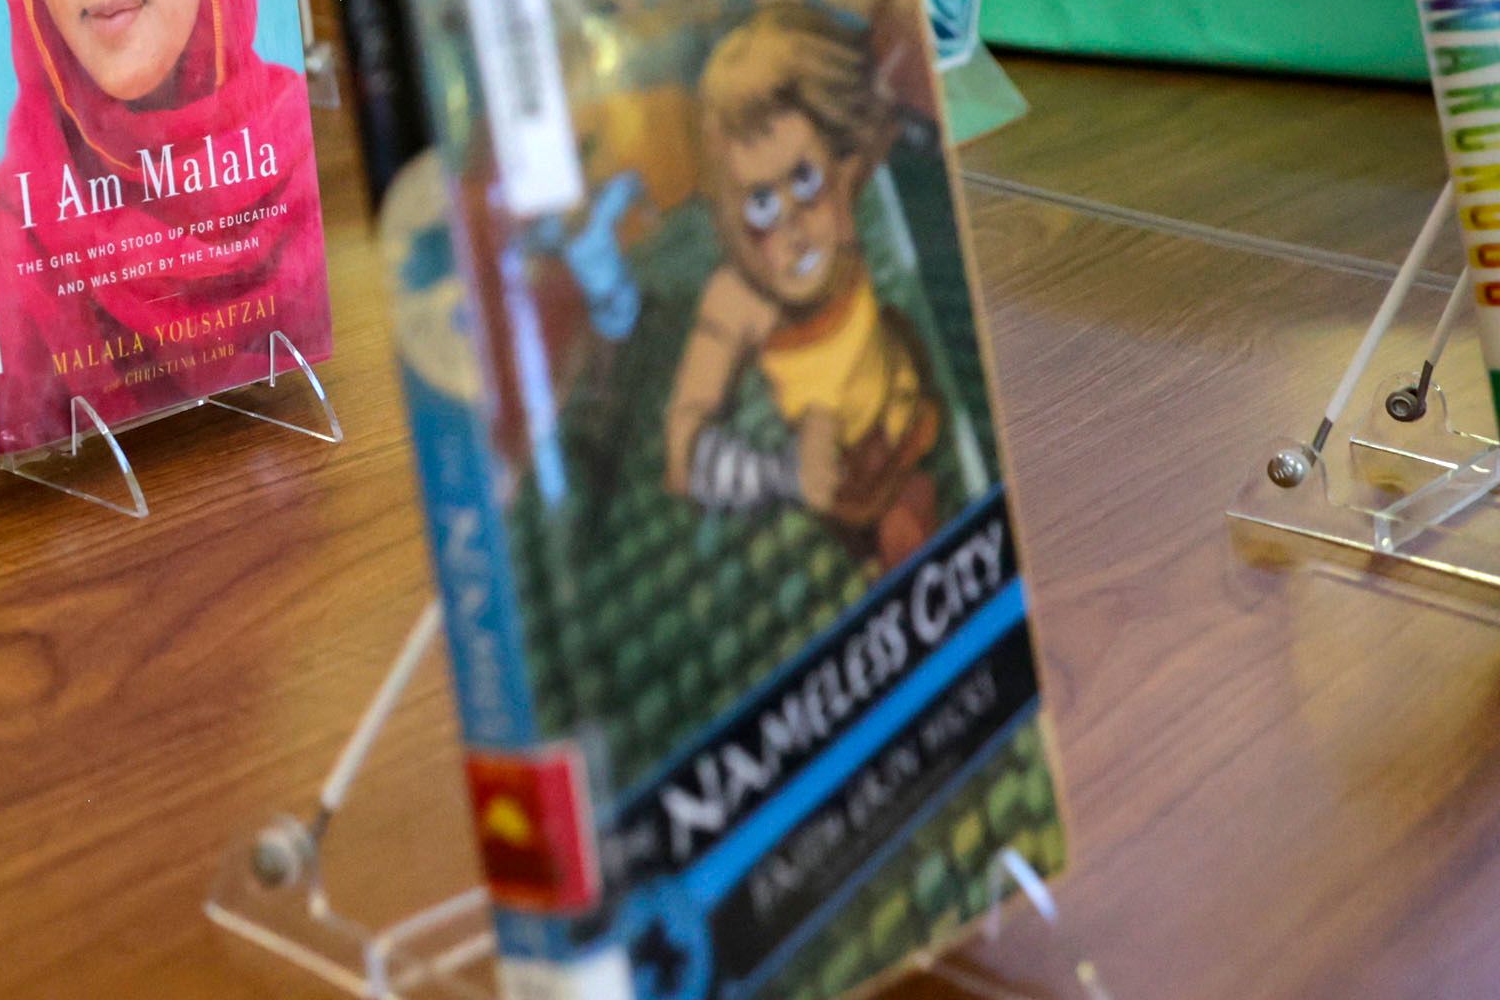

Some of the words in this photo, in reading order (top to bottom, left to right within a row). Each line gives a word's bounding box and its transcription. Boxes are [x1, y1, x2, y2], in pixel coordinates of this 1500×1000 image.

[14, 172, 37, 229] I
[57, 164, 125, 222] Am
[137, 127, 278, 203] Malala
[17, 262, 43, 276] THE
[50, 252, 81, 270] GIRL
[87, 243, 115, 259] WHO
[120, 232, 163, 252] STOOD
[168, 227, 184, 240] UP
[190, 220, 214, 236] FOR
[219, 203, 288, 229] EDUCATION
[57, 281, 85, 296] AND
[90, 272, 117, 288] WAS
[122, 262, 153, 280] SHOT
[158, 258, 175, 271] BY
[180, 250, 203, 265] THE
[208, 237, 260, 258] TALIBAN
[52, 331, 144, 376] MALALA
[154, 295, 277, 347] YOUSAFZAI
[124, 357, 197, 386] CHRISTINA
[202, 343, 236, 363] LAMB
[660, 610, 908, 860] NAMELESS
[909, 517, 1003, 643] CITY
